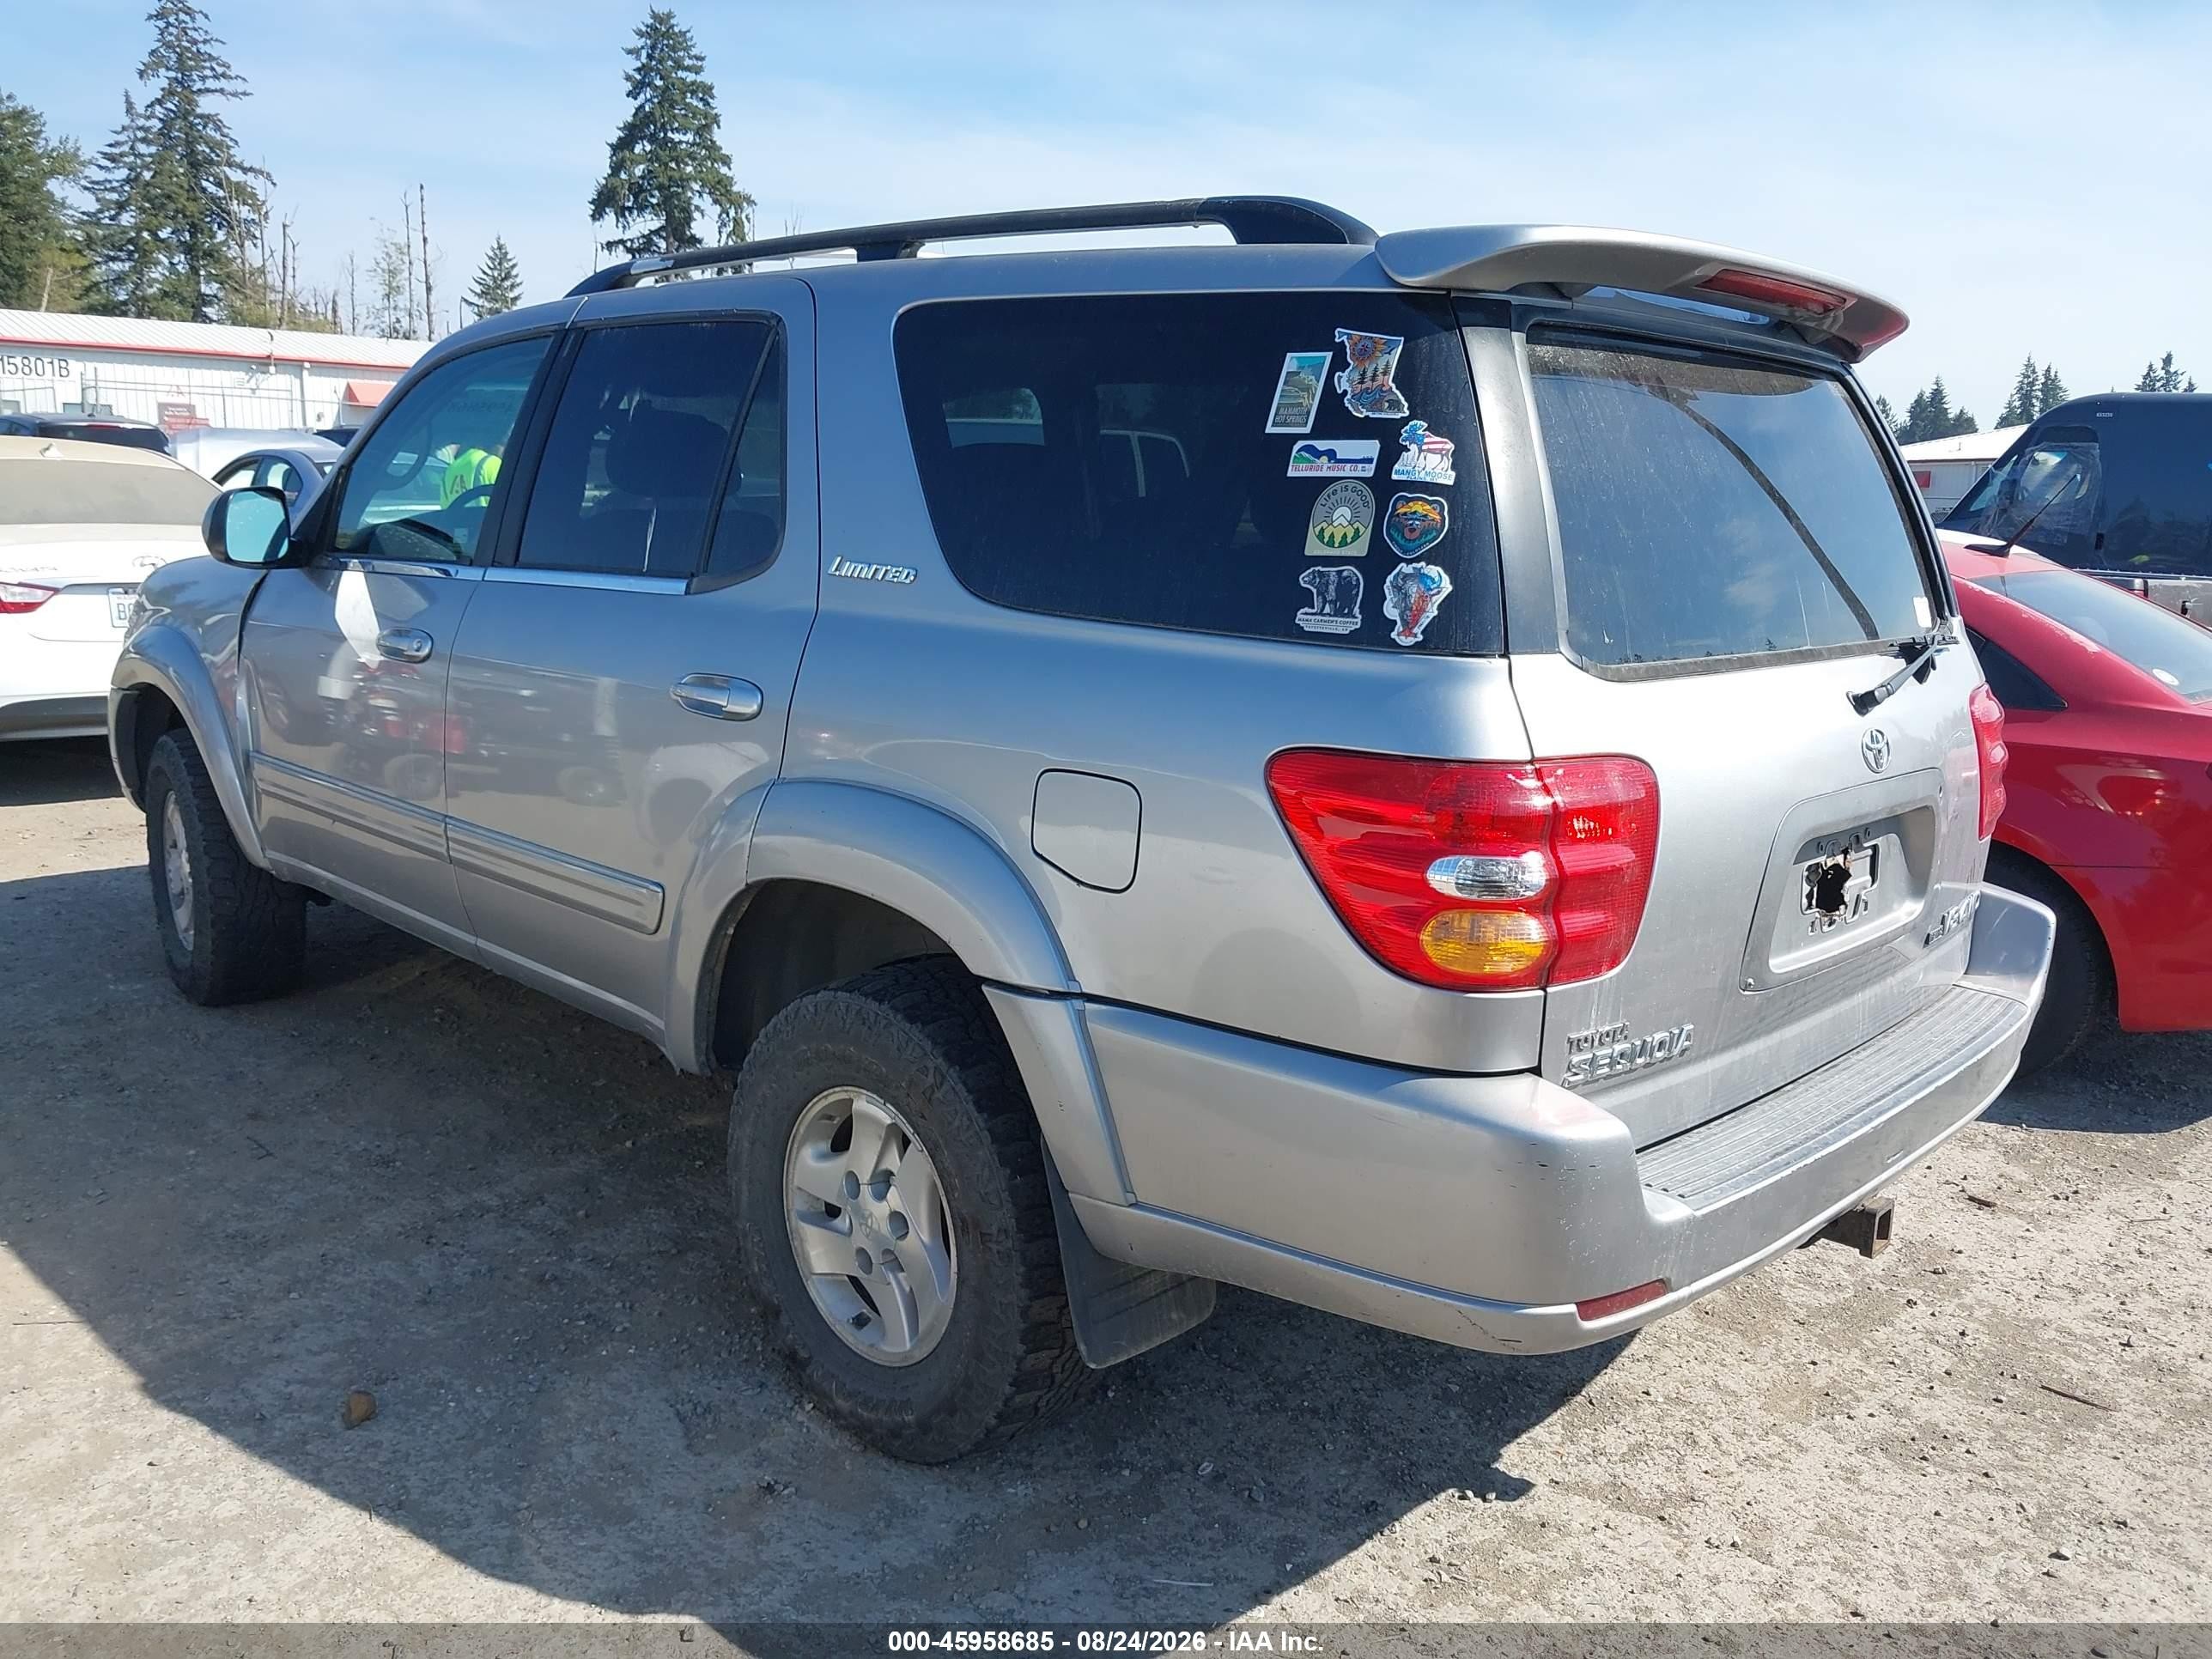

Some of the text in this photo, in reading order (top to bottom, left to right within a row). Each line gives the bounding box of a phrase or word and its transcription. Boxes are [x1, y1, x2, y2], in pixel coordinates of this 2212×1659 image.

[1274, 415, 1308, 423] HOT SPRINGS
[1394, 468, 1453, 481] MANGY MOOSE
[1566, 1020, 1630, 1054] TOYOTA
[1561, 1023, 1695, 1088] SEQUOIA
